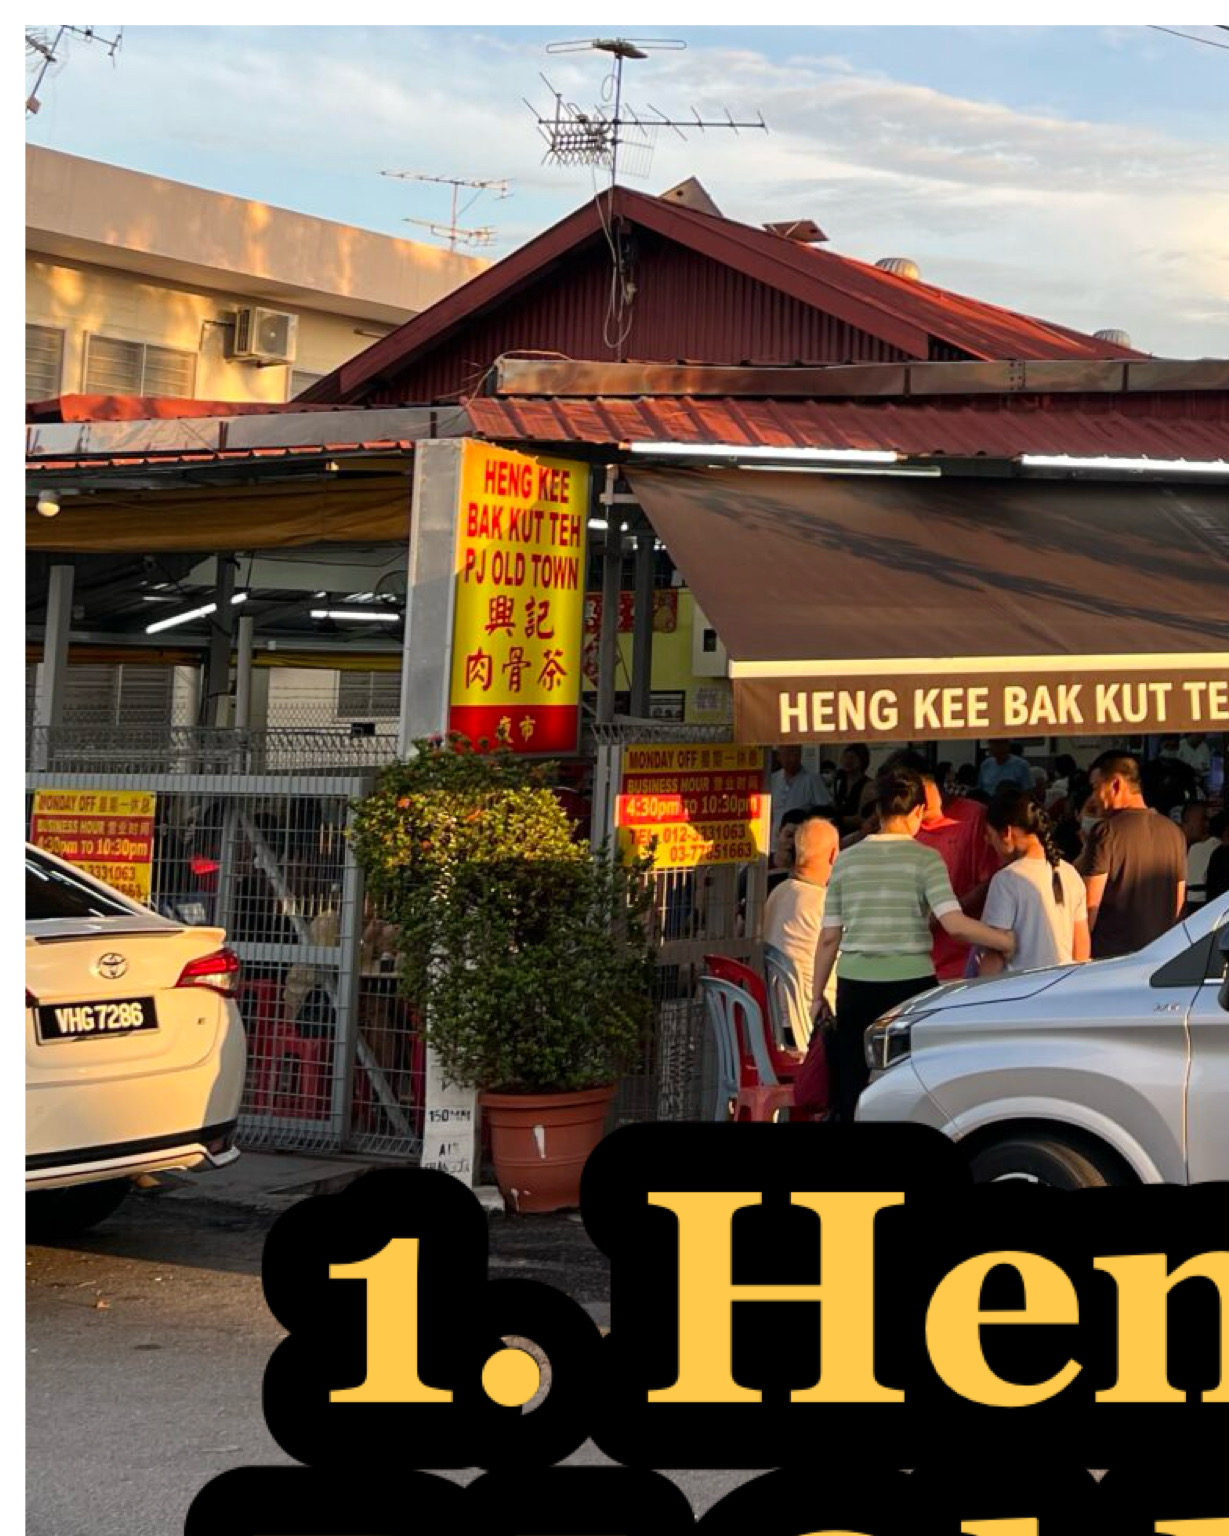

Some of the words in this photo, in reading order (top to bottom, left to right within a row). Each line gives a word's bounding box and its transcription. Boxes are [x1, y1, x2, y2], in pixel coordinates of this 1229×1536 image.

[484, 459, 532, 499] HENG
[538, 466, 570, 503] KEE
[467, 502, 502, 540] BAK
[508, 507, 544, 544] KUT
[549, 512, 581, 547] TEH
[464, 548, 486, 584] PJ
[492, 551, 525, 586] OLD
[531, 554, 579, 590] TOWN
[485, 595, 554, 639] 興記
[466, 646, 567, 692] 肉骨茶
[779, 689, 899, 733] HENG
[914, 687, 989, 730] KEE
[1003, 684, 1084, 726] BAK
[1095, 682, 1172, 724] KUT
[629, 751, 675, 769] MONDAY
[677, 751, 698, 768] OFF
[79, 795, 97, 812] OFF
[627, 778, 679, 794] BUSINESS
[681, 777, 710, 792] HOUR
[626, 797, 678, 819] 4:30pm
[701, 795, 758, 816] 10:30pm
[98, 838, 148, 860] 10:30pm
[54, 1005, 94, 1034] VHG
[94, 1002, 144, 1029] 7286
